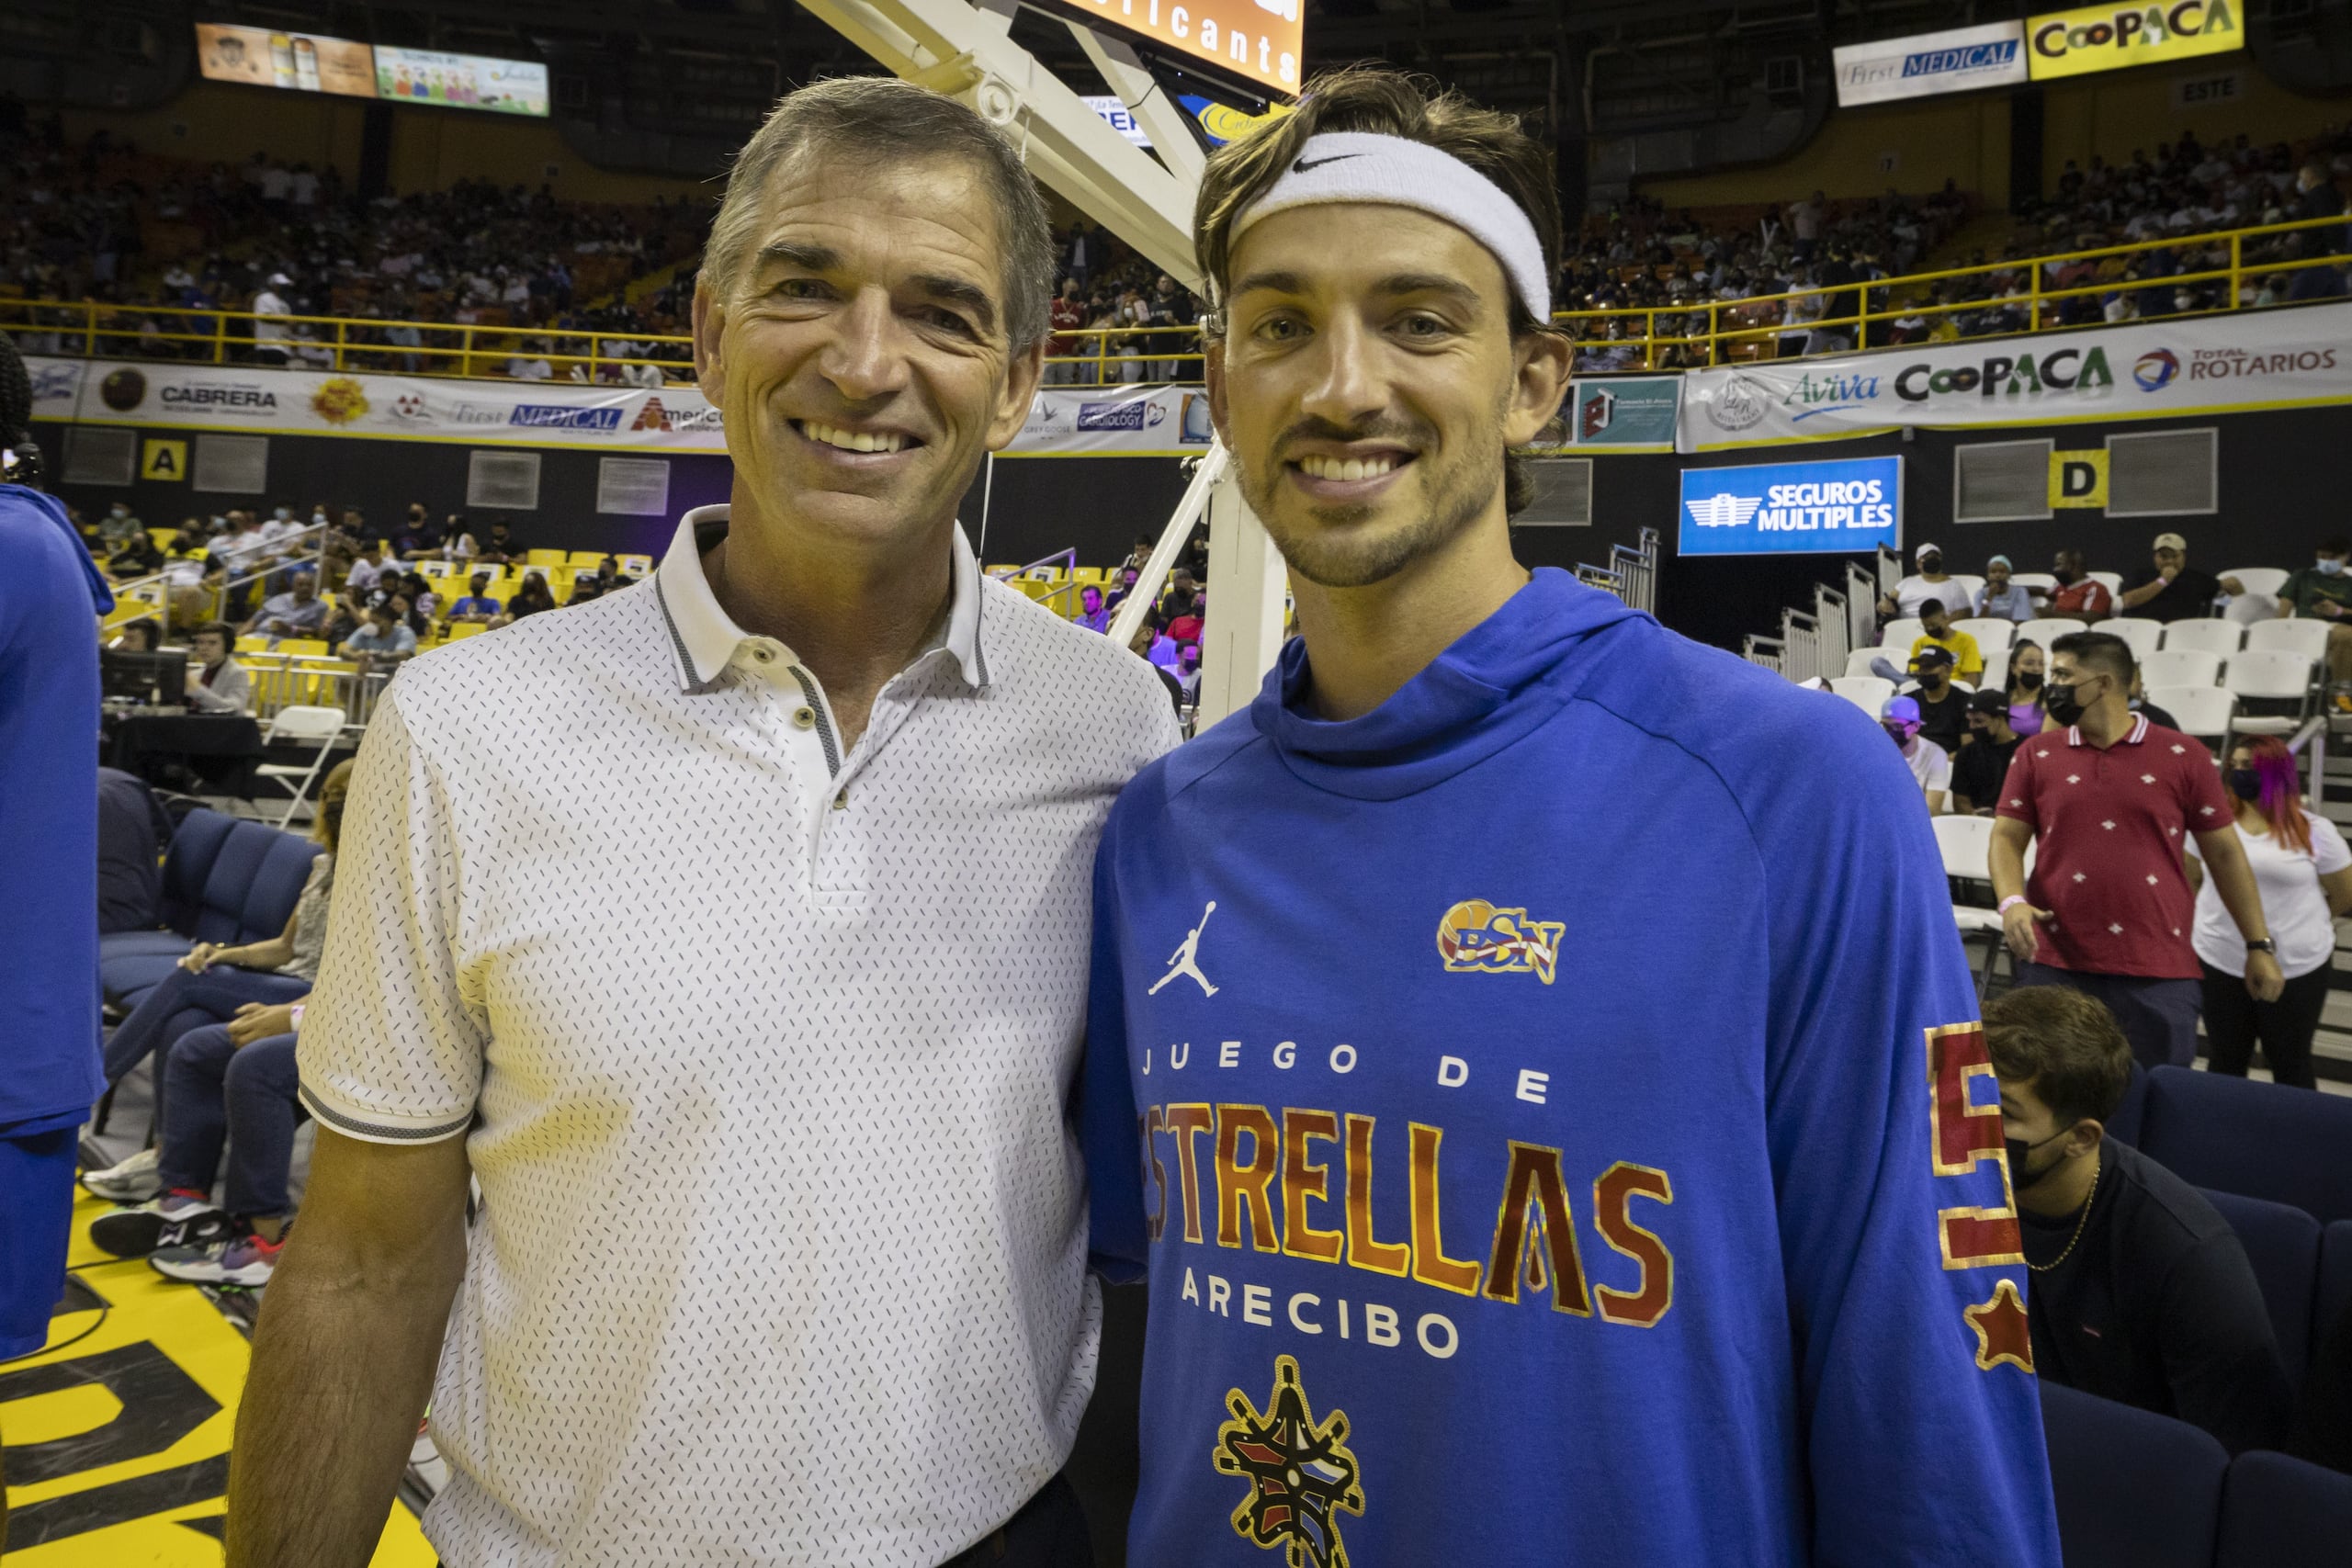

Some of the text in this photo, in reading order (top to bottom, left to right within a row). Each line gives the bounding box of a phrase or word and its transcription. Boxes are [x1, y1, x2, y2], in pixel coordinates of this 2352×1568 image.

[1850, 63, 1894, 84] First
[1906, 42, 2015, 76] MEDICAL
[2183, 77, 2234, 102] ESTE
[2190, 349, 2336, 380] ROTARIOS
[161, 387, 277, 408] CABRERA
[1783, 373, 1881, 405] Aviva
[456, 402, 504, 424] First
[514, 406, 618, 429] MEDICAL
[152, 447, 175, 472] A
[1768, 479, 1883, 509] SEGUROS
[2062, 461, 2097, 497] D
[1758, 504, 1894, 532] MULTIPLES
[1450, 913, 1560, 978] BSN
[1143, 1041, 1550, 1105] JUEGO DE
[1137, 1101, 1674, 1328] STRELLAS
[1181, 1266, 1460, 1359] ARECIBO
